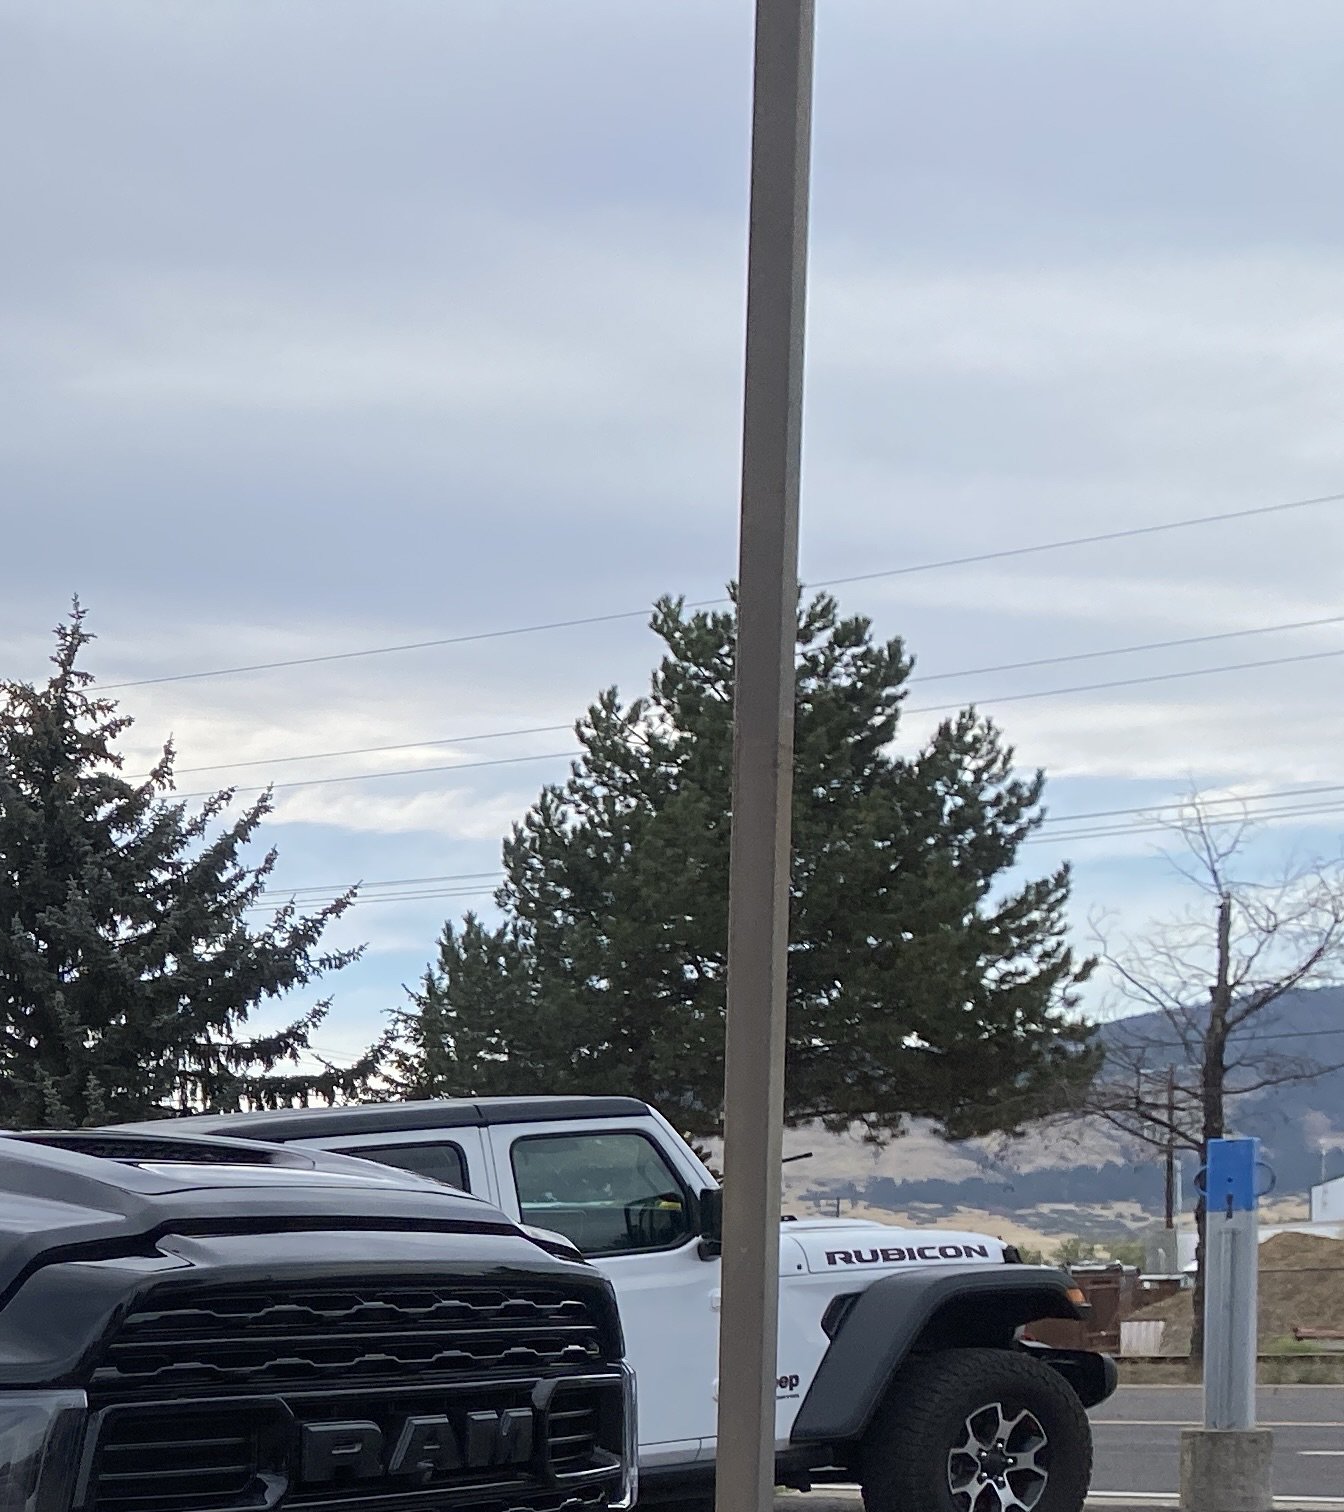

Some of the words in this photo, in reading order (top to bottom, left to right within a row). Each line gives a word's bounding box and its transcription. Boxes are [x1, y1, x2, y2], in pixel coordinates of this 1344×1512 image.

[825, 1244, 990, 1267] RUBICON
[776, 1374, 800, 1391] ep
[302, 1407, 534, 1482] RAM
